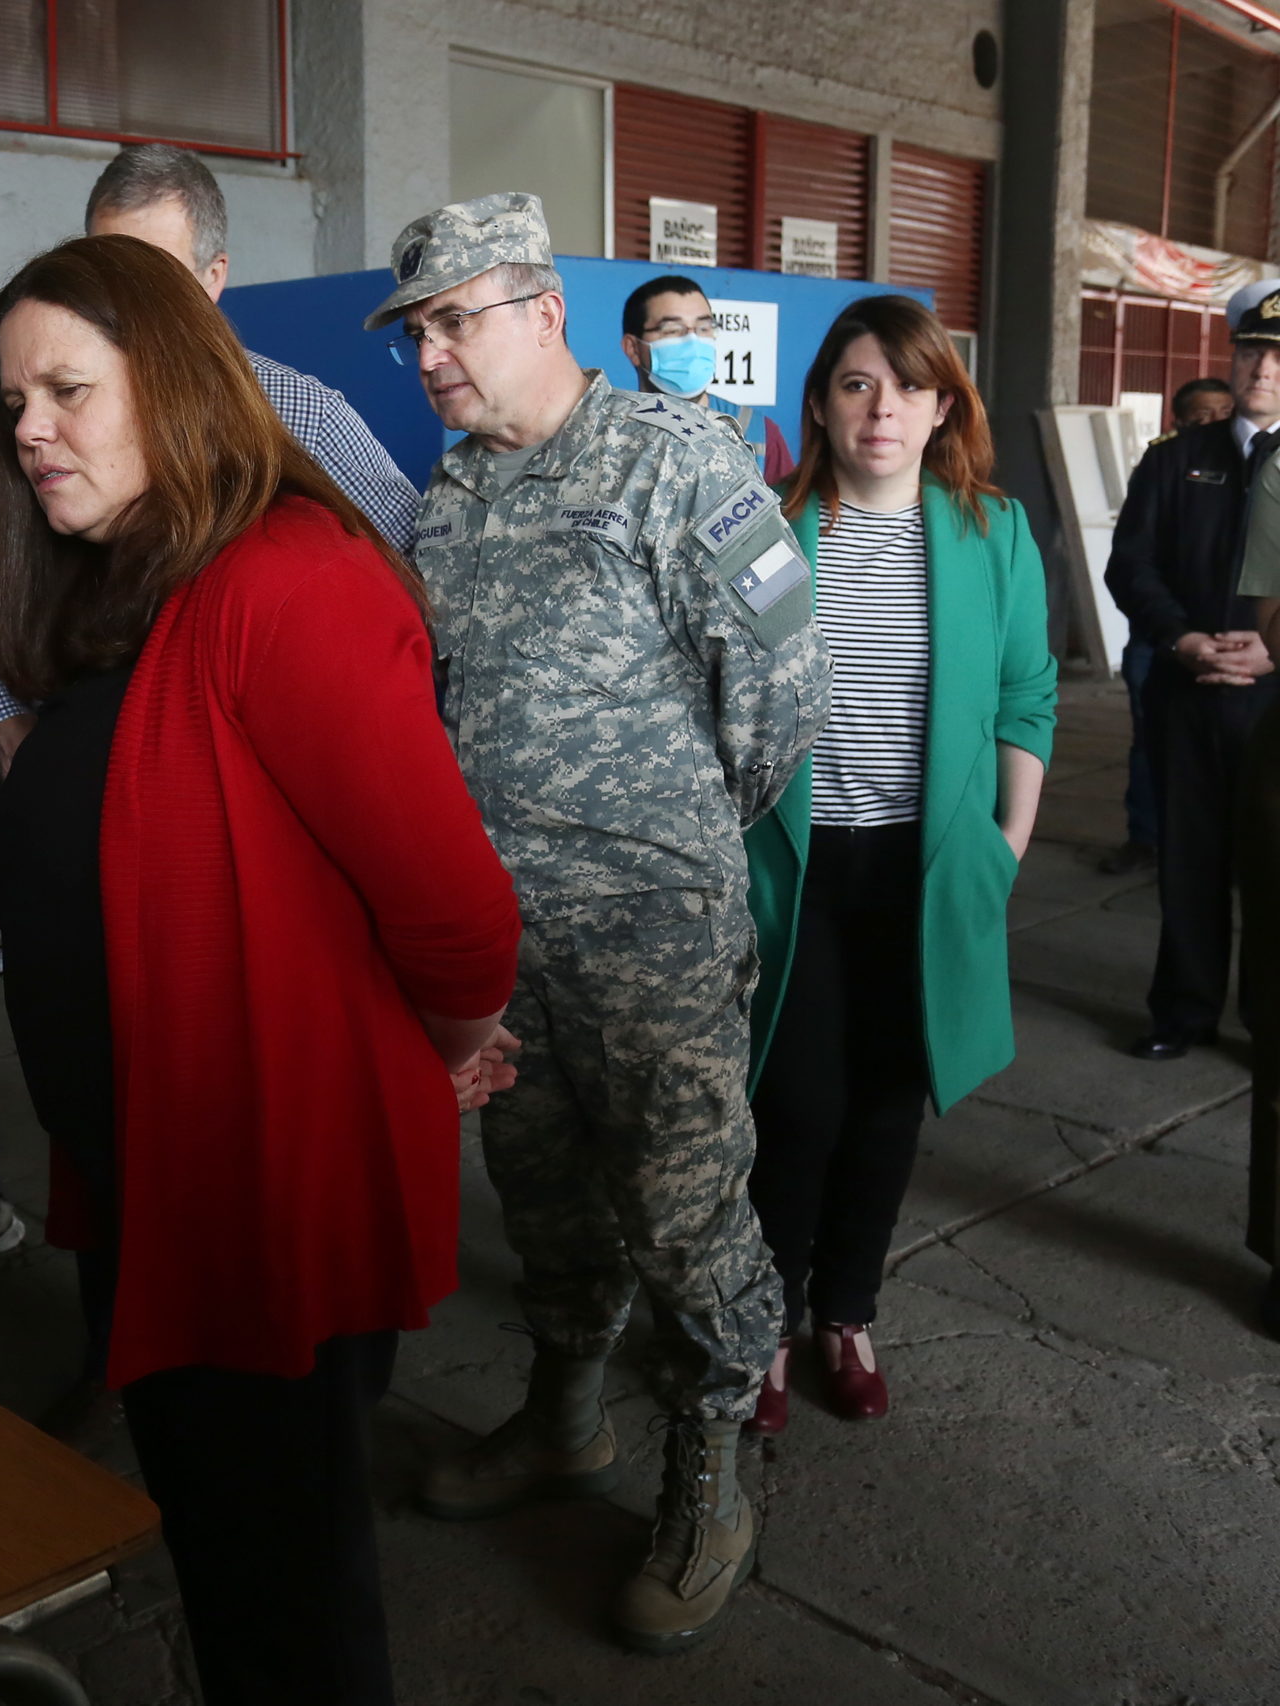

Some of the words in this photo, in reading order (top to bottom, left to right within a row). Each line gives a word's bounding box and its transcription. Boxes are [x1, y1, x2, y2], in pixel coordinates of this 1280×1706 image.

[712, 313, 750, 332] MESA
[561, 509, 593, 519] FUERZA
[594, 509, 628, 529] AEREA
[582, 518, 610, 530] CHILE
[708, 490, 765, 543] FACH
